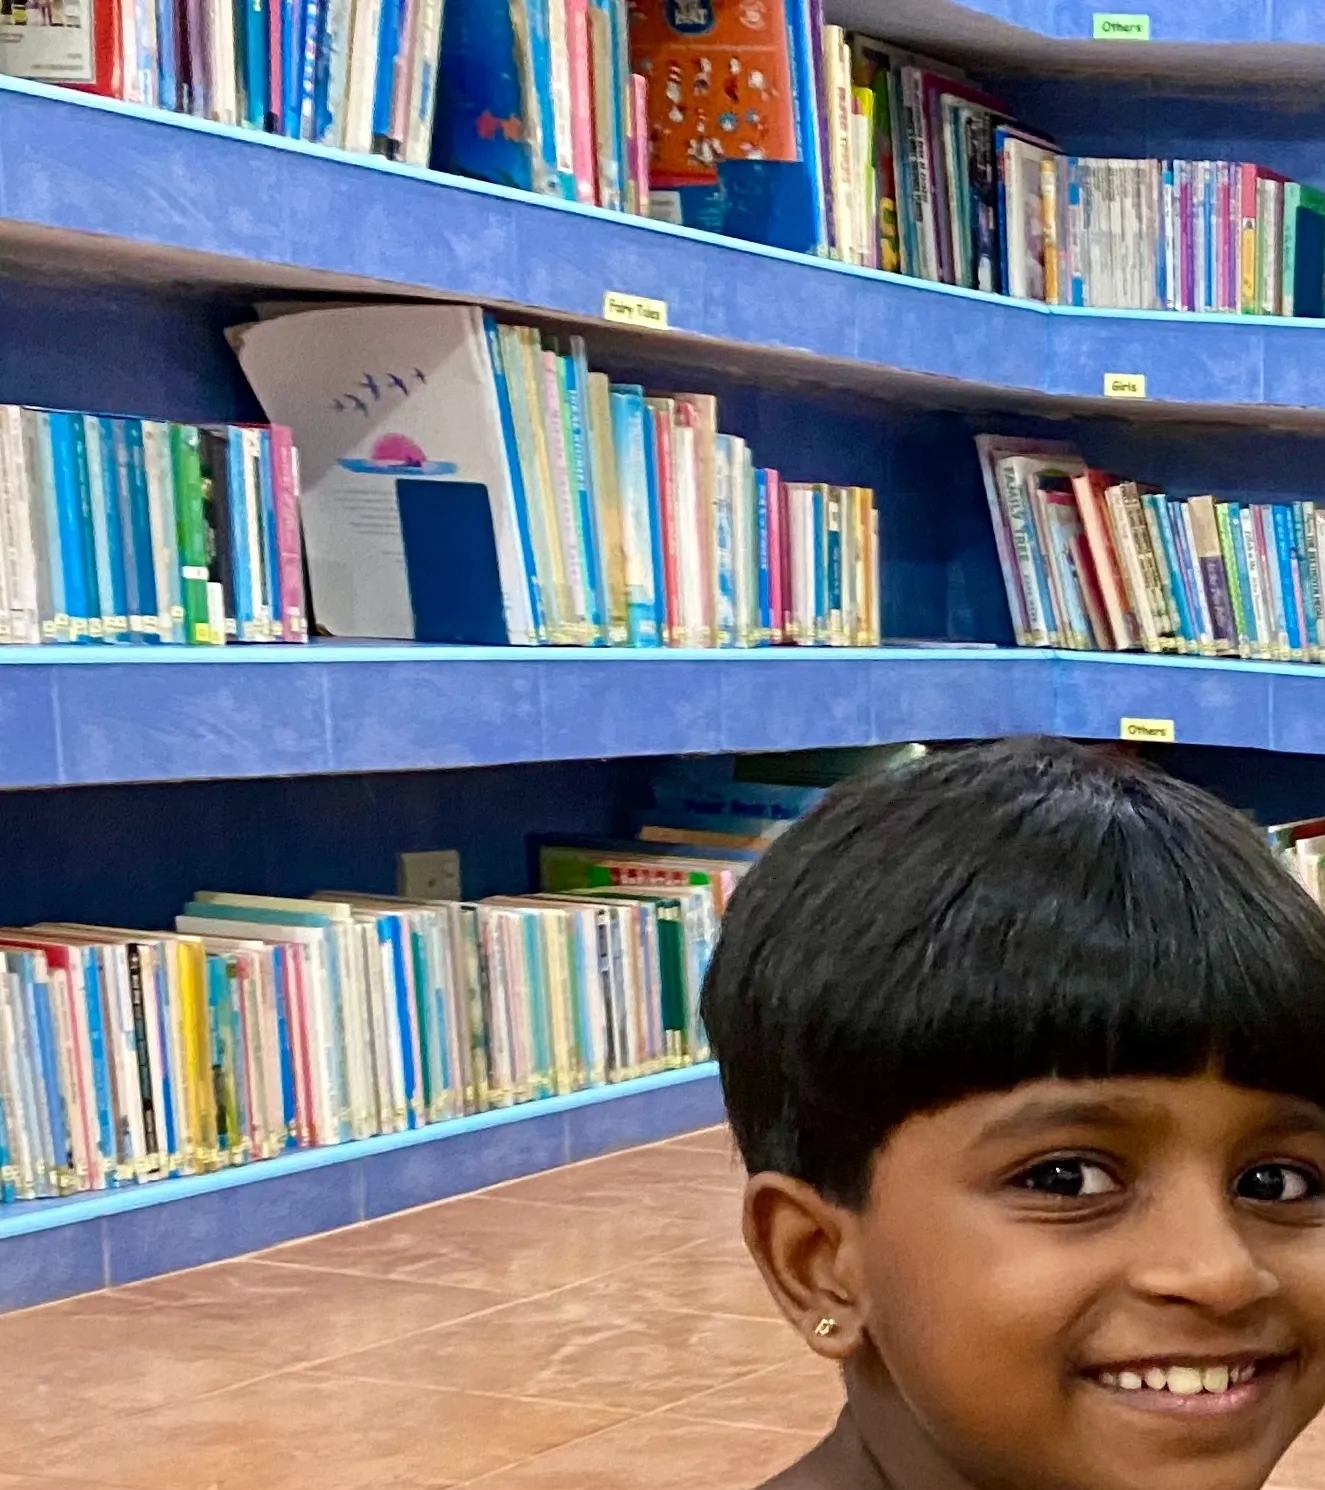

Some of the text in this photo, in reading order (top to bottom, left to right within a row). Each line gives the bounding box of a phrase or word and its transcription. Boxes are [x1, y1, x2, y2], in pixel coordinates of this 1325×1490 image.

[1102, 21, 1142, 34] Others
[609, 300, 634, 318] Fairy
[1112, 381, 1137, 393] Girls
[1128, 724, 1166, 737] Others
